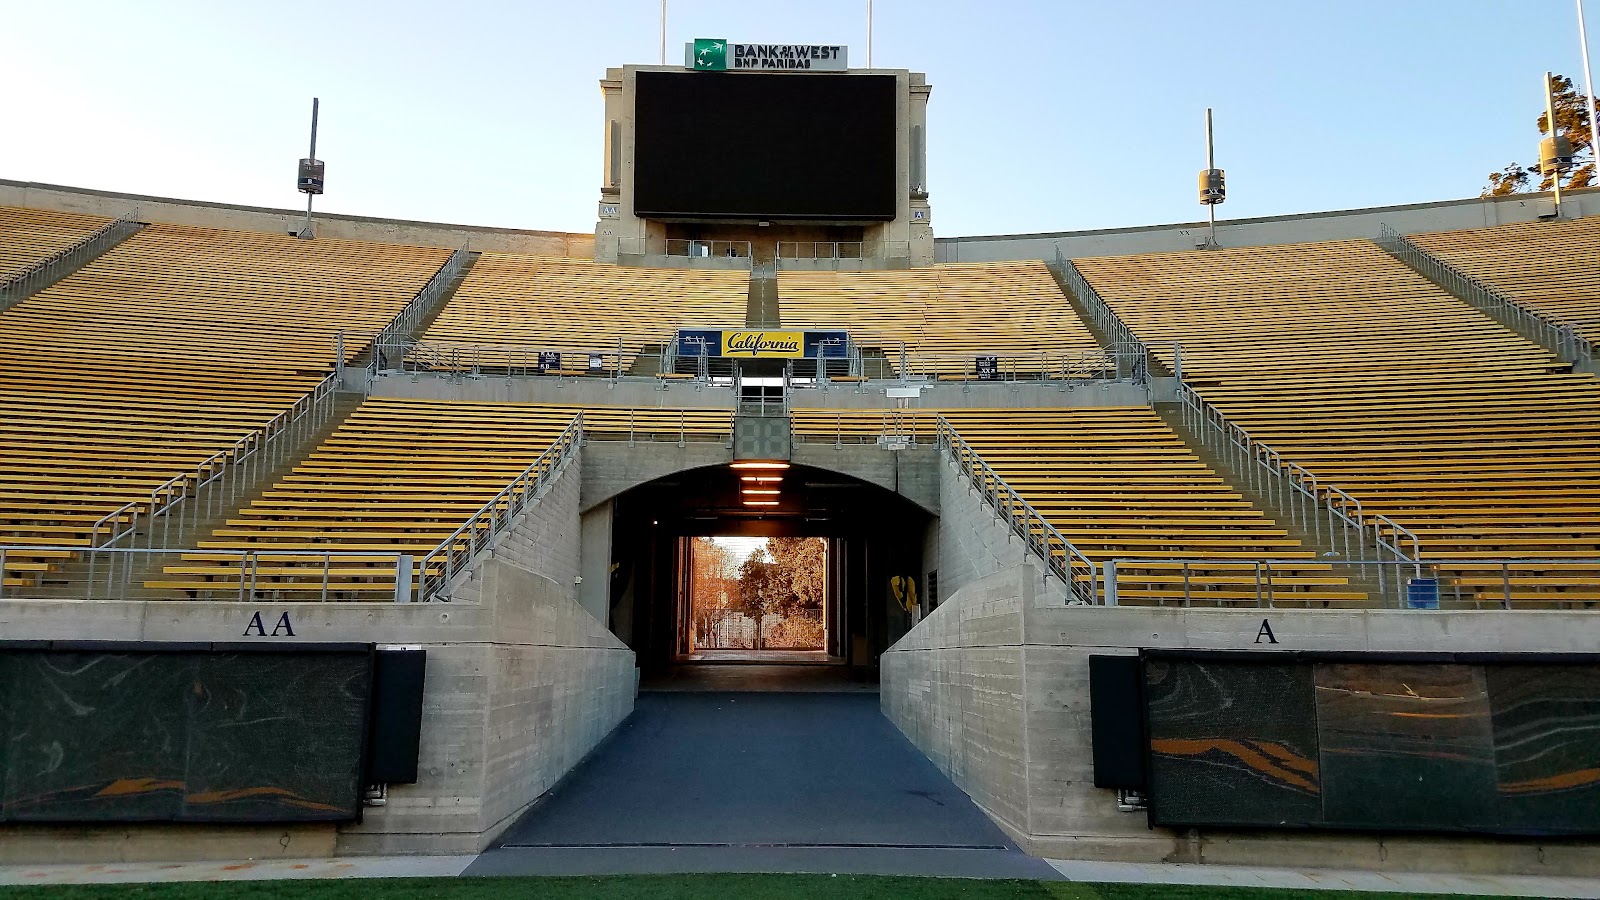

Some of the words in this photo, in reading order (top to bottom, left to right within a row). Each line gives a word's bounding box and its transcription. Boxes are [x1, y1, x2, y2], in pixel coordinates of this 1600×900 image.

[735, 44, 778, 58] BANK
[795, 45, 840, 59] WEST
[735, 58, 759, 68] BNP
[761, 58, 811, 69] PARIBAS
[727, 332, 800, 356] California
[242, 610, 296, 637] AA
[1253, 618, 1280, 644] A
